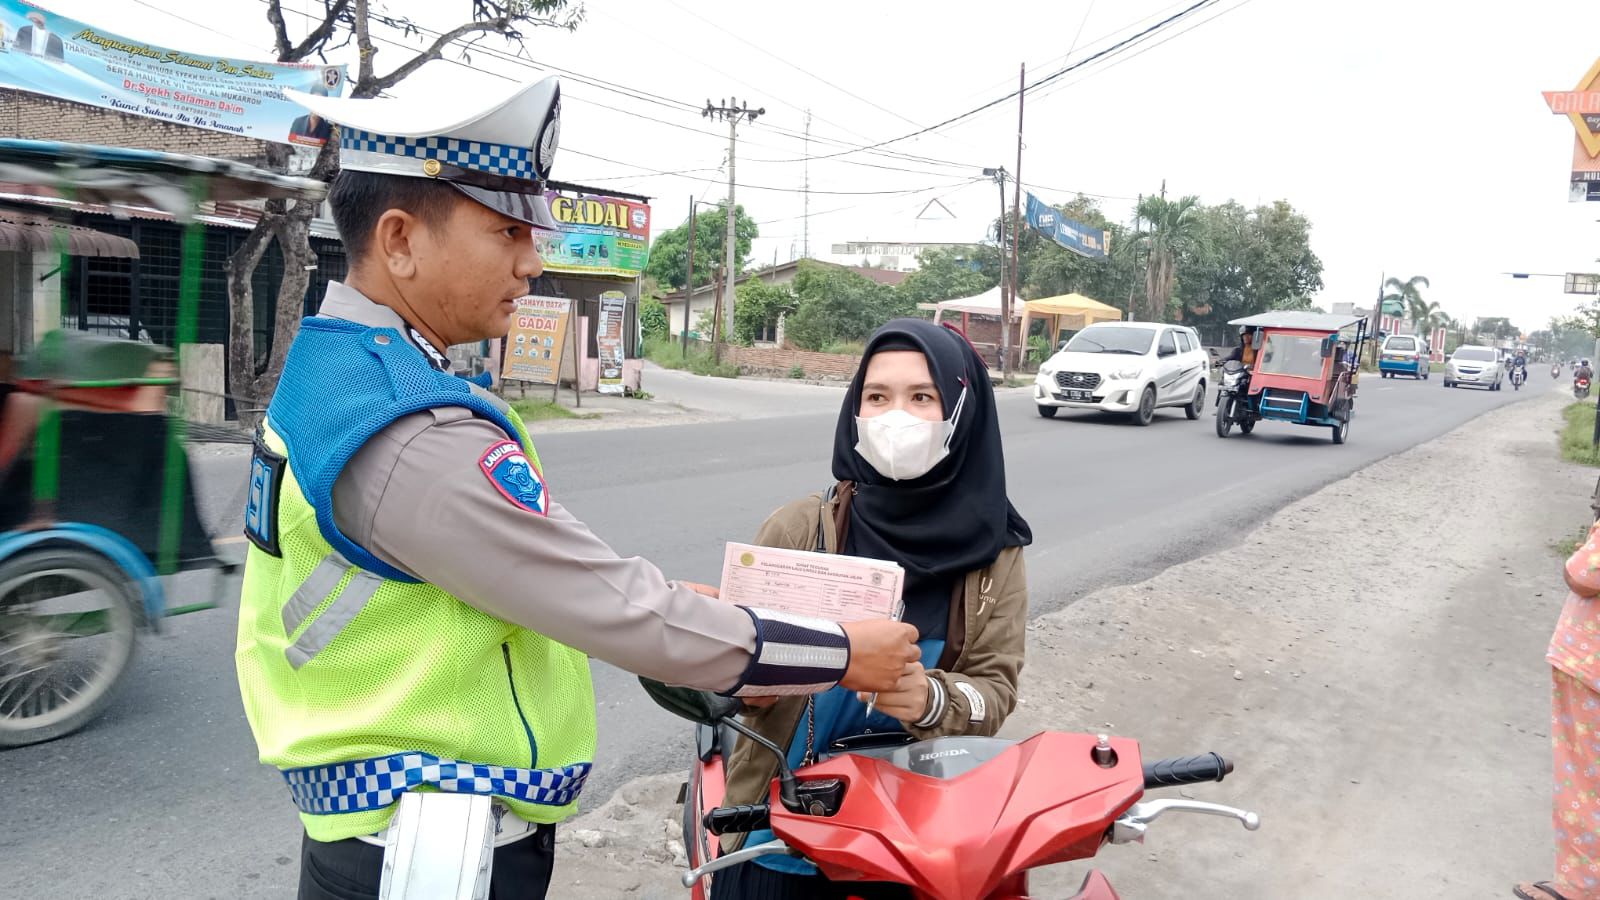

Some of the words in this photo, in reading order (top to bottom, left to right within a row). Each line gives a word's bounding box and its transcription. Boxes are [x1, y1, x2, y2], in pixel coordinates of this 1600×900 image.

[72, 29, 160, 60] Mengucapkan
[160, 50, 214, 70] Selamat
[216, 60, 239, 74] Dan
[106, 64, 134, 77] SERTA
[136, 71, 158, 83] HAUL
[221, 91, 262, 105] MUKARROM
[109, 98, 140, 112] Kunci
[551, 197, 629, 230] GADAI
[518, 317, 557, 331] GADAI
[920, 749, 969, 761] HONDA
